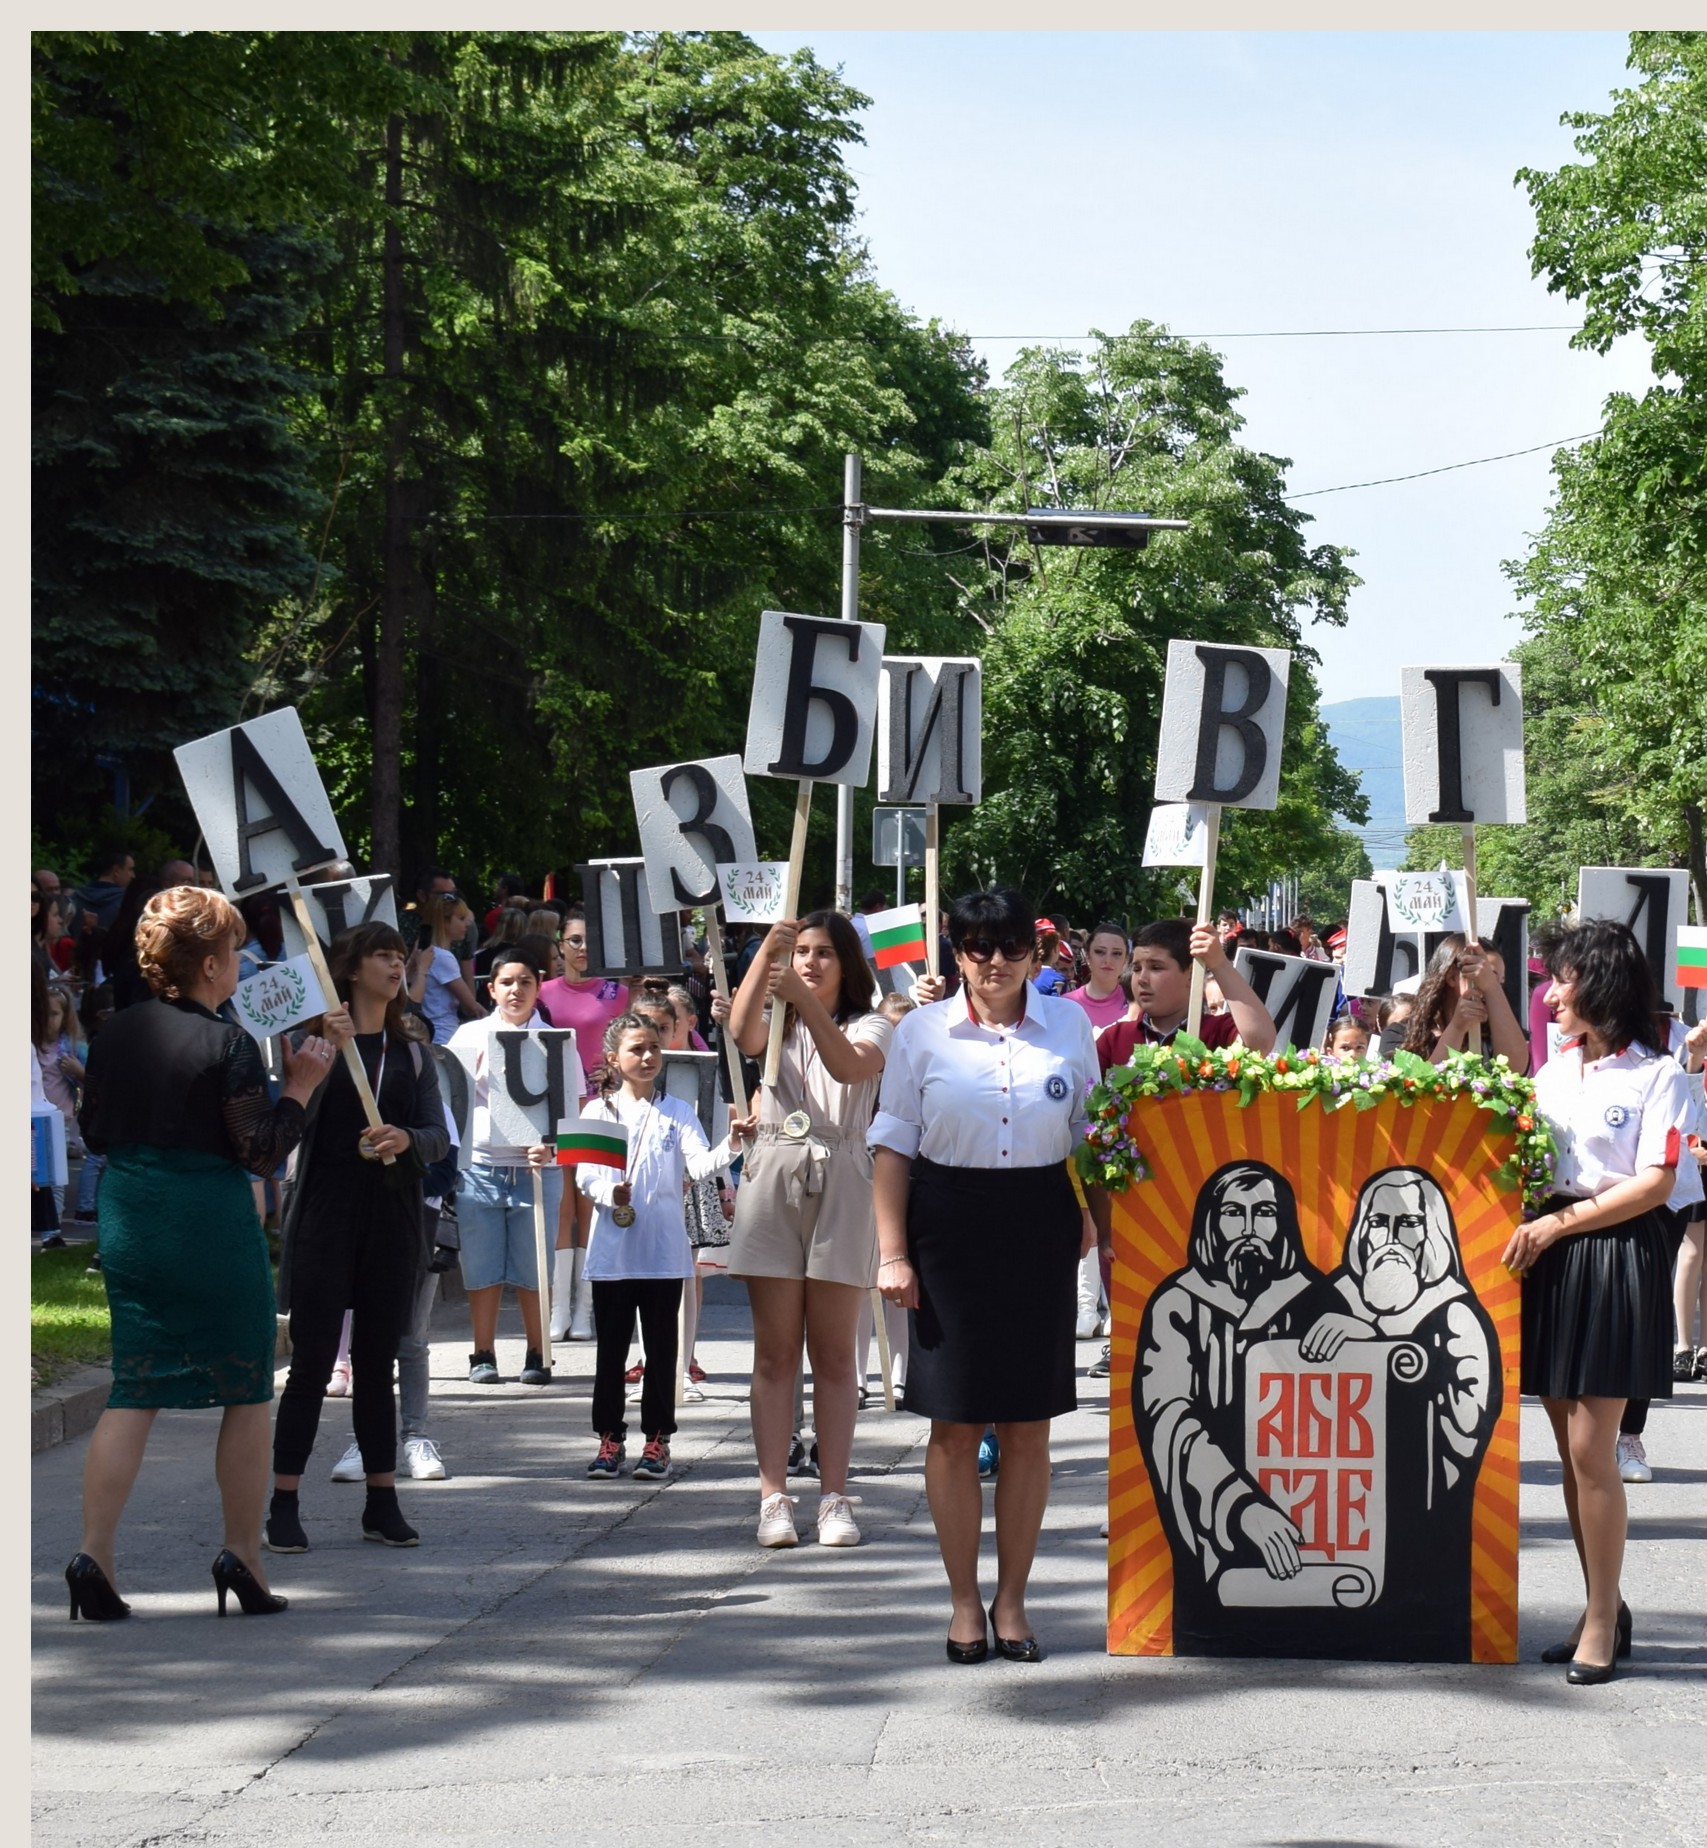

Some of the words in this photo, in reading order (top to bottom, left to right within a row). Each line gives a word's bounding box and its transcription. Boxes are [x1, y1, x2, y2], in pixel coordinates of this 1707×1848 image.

[768, 616, 862, 778] Б
[880, 662, 974, 800] И
[1185, 645, 1270, 803] В
[1424, 669, 1501, 822] Г
[229, 727, 336, 888] А
[659, 764, 737, 906] З
[743, 884, 772, 900] МАЙ
[746, 870, 765, 884] 24
[1409, 892, 1442, 910] МАЙ
[1415, 880, 1434, 894] 24
[259, 976, 279, 994] 24
[261, 987, 293, 1013] МАЙ
[496, 1030, 572, 1146] Ч
[1256, 1371, 1374, 1459] АБВ
[1257, 1467, 1373, 1562] ГДЕ
